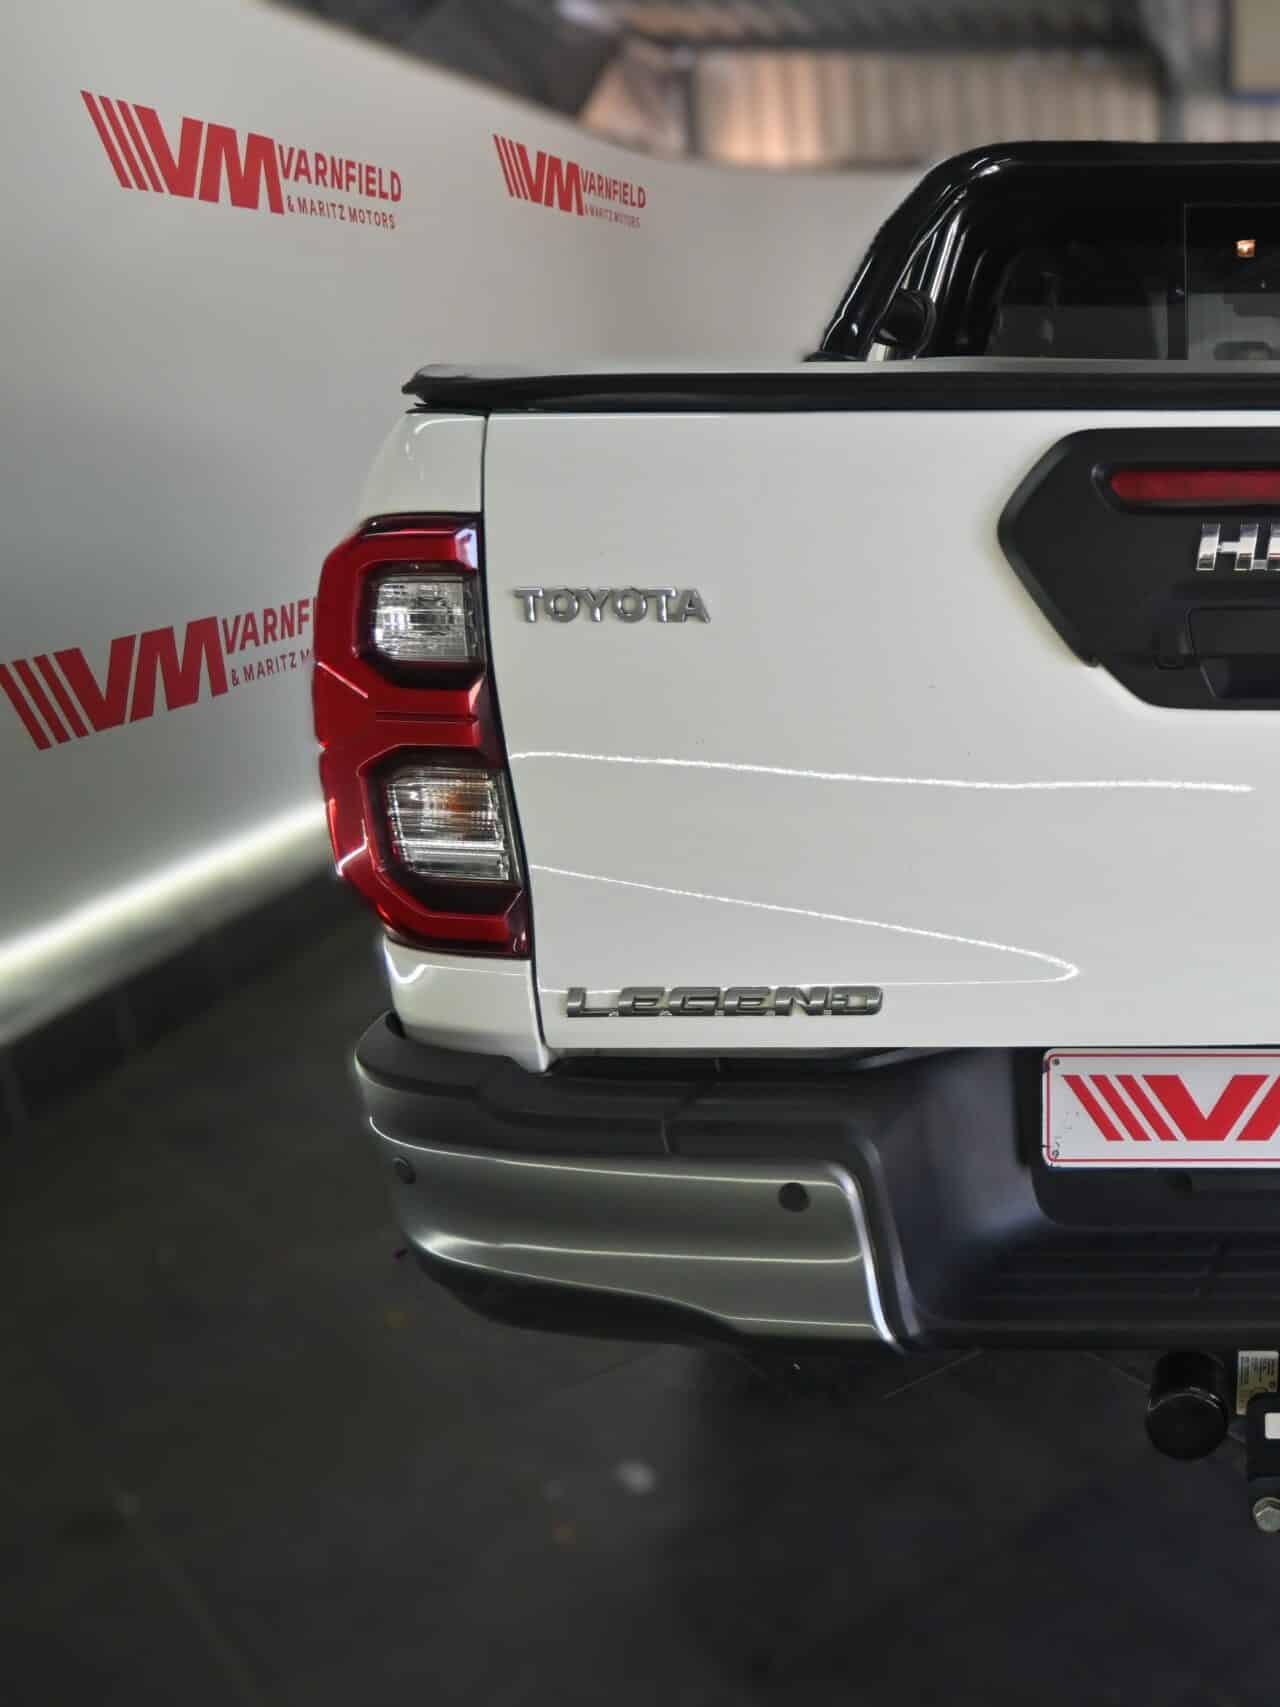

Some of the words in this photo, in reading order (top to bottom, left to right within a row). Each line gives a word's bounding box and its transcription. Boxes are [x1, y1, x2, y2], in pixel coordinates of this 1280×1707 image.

[132, 103, 285, 215] VM
[278, 143, 402, 203] VARNFIELD
[515, 141, 584, 216] VM
[287, 195, 295, 213] &
[297, 196, 346, 221] MARITZ
[348, 206, 396, 230] MOTORS
[580, 168, 647, 209] VARNFIELD
[222, 597, 317, 655] VARNF
[512, 585, 712, 624] TOYOTA
[53, 615, 229, 733] VM
[231, 667, 241, 688] &
[243, 651, 297, 682] MARITZ
[567, 986, 884, 1018] LEGEND
